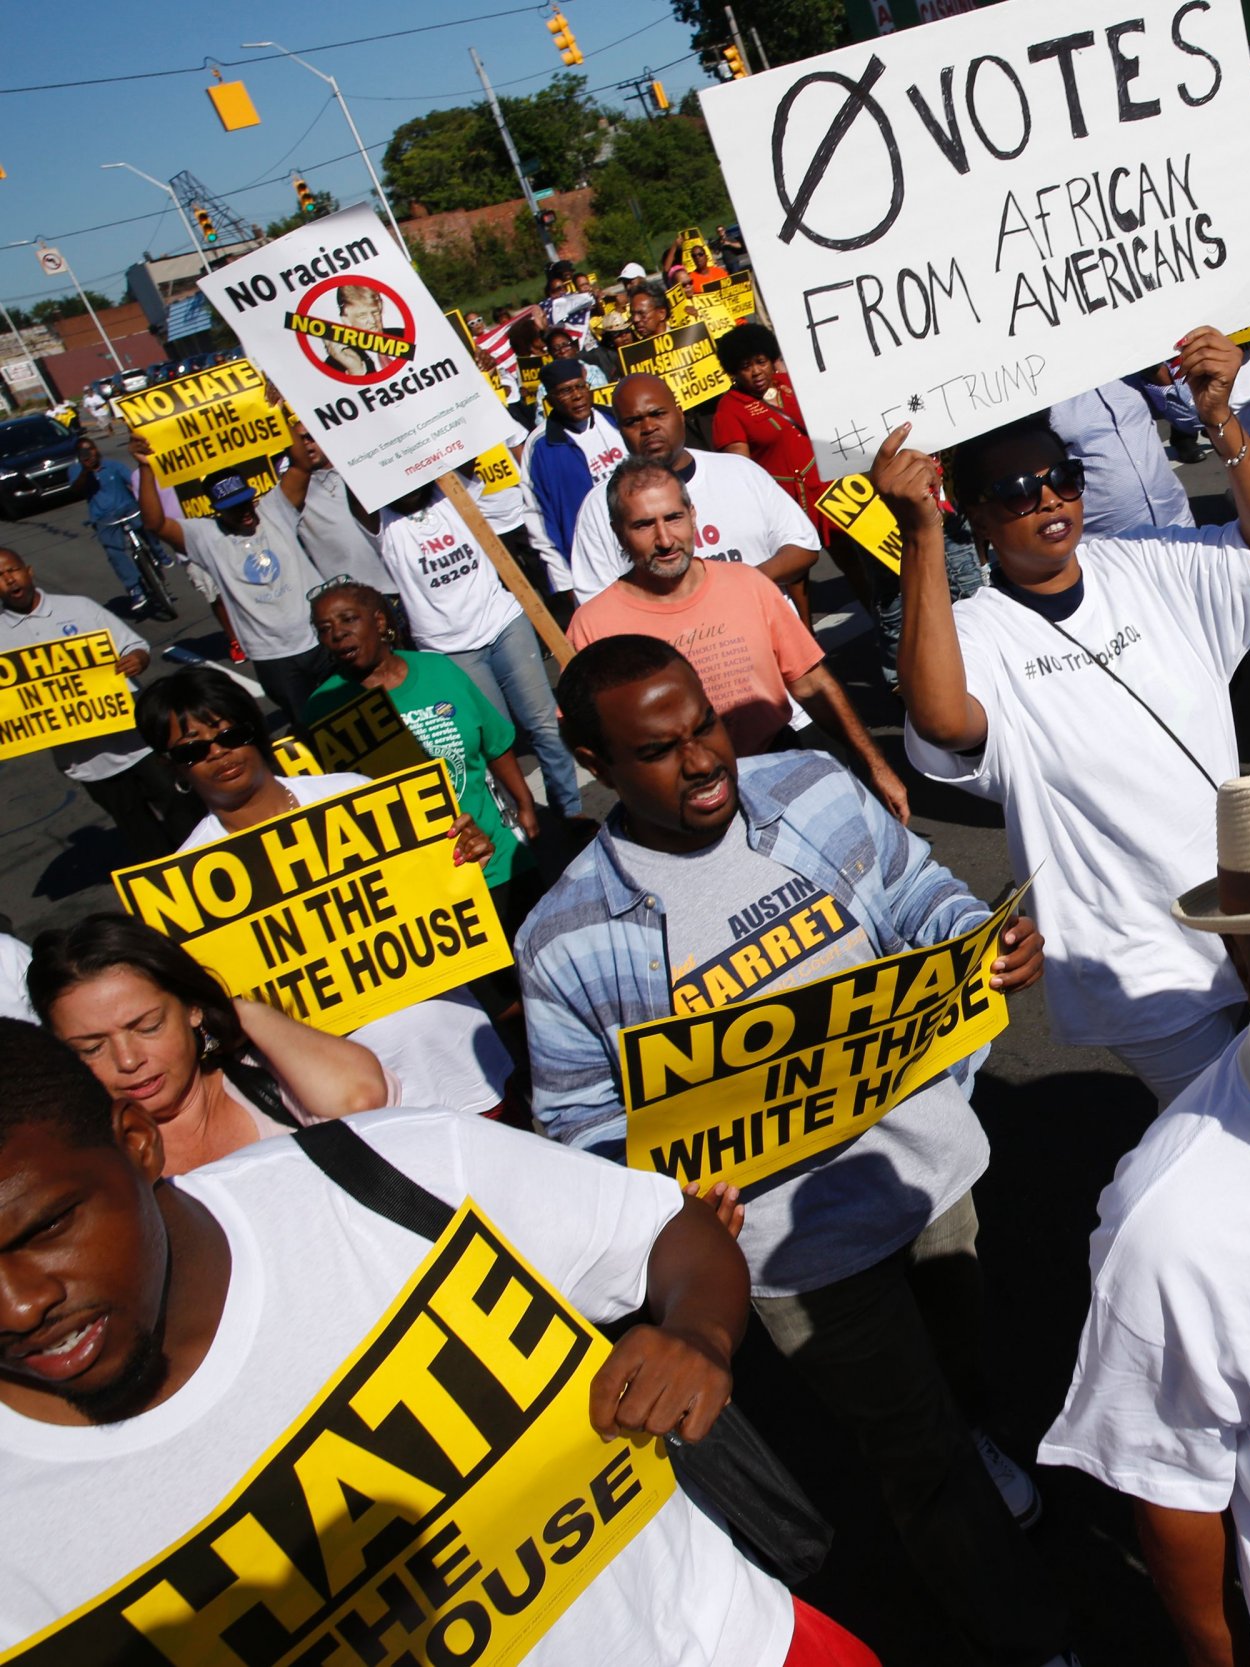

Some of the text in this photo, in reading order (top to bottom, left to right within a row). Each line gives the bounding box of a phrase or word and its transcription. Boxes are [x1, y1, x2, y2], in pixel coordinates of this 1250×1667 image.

[906, 0, 1222, 175] VOTES
[995, 153, 1199, 273] AFRICAN
[224, 236, 379, 313] NO racism
[1008, 212, 1228, 338] AMERICANS
[291, 315, 410, 358] NO TRUMP
[654, 334, 673, 354] NO
[803, 256, 981, 373] FROM
[630, 338, 713, 375] ANTI-SEMITISM
[670, 366, 697, 388] THE
[680, 369, 725, 401] HOUSE
[121, 362, 264, 426] NO HATE
[180, 398, 240, 440] IN THE
[314, 397, 359, 431] NO
[357, 358, 460, 413] Fascism
[155, 416, 281, 476] WHITE HOUSE
[404, 439, 465, 476] mecawi.org
[822, 473, 874, 525] NO
[418, 542, 475, 575] Trump
[430, 560, 479, 588] 48204
[20, 633, 117, 680] HATE
[17, 674, 88, 711] IN THE
[61, 691, 130, 727] HOUSE
[128, 770, 456, 938] NO HATE
[249, 869, 398, 970] IN THE
[728, 877, 817, 940] AUSTIN
[341, 897, 488, 995] HOUSE
[638, 1004, 796, 1101] NO
[763, 999, 949, 1103] IN THE
[649, 1087, 839, 1184] WHITE
